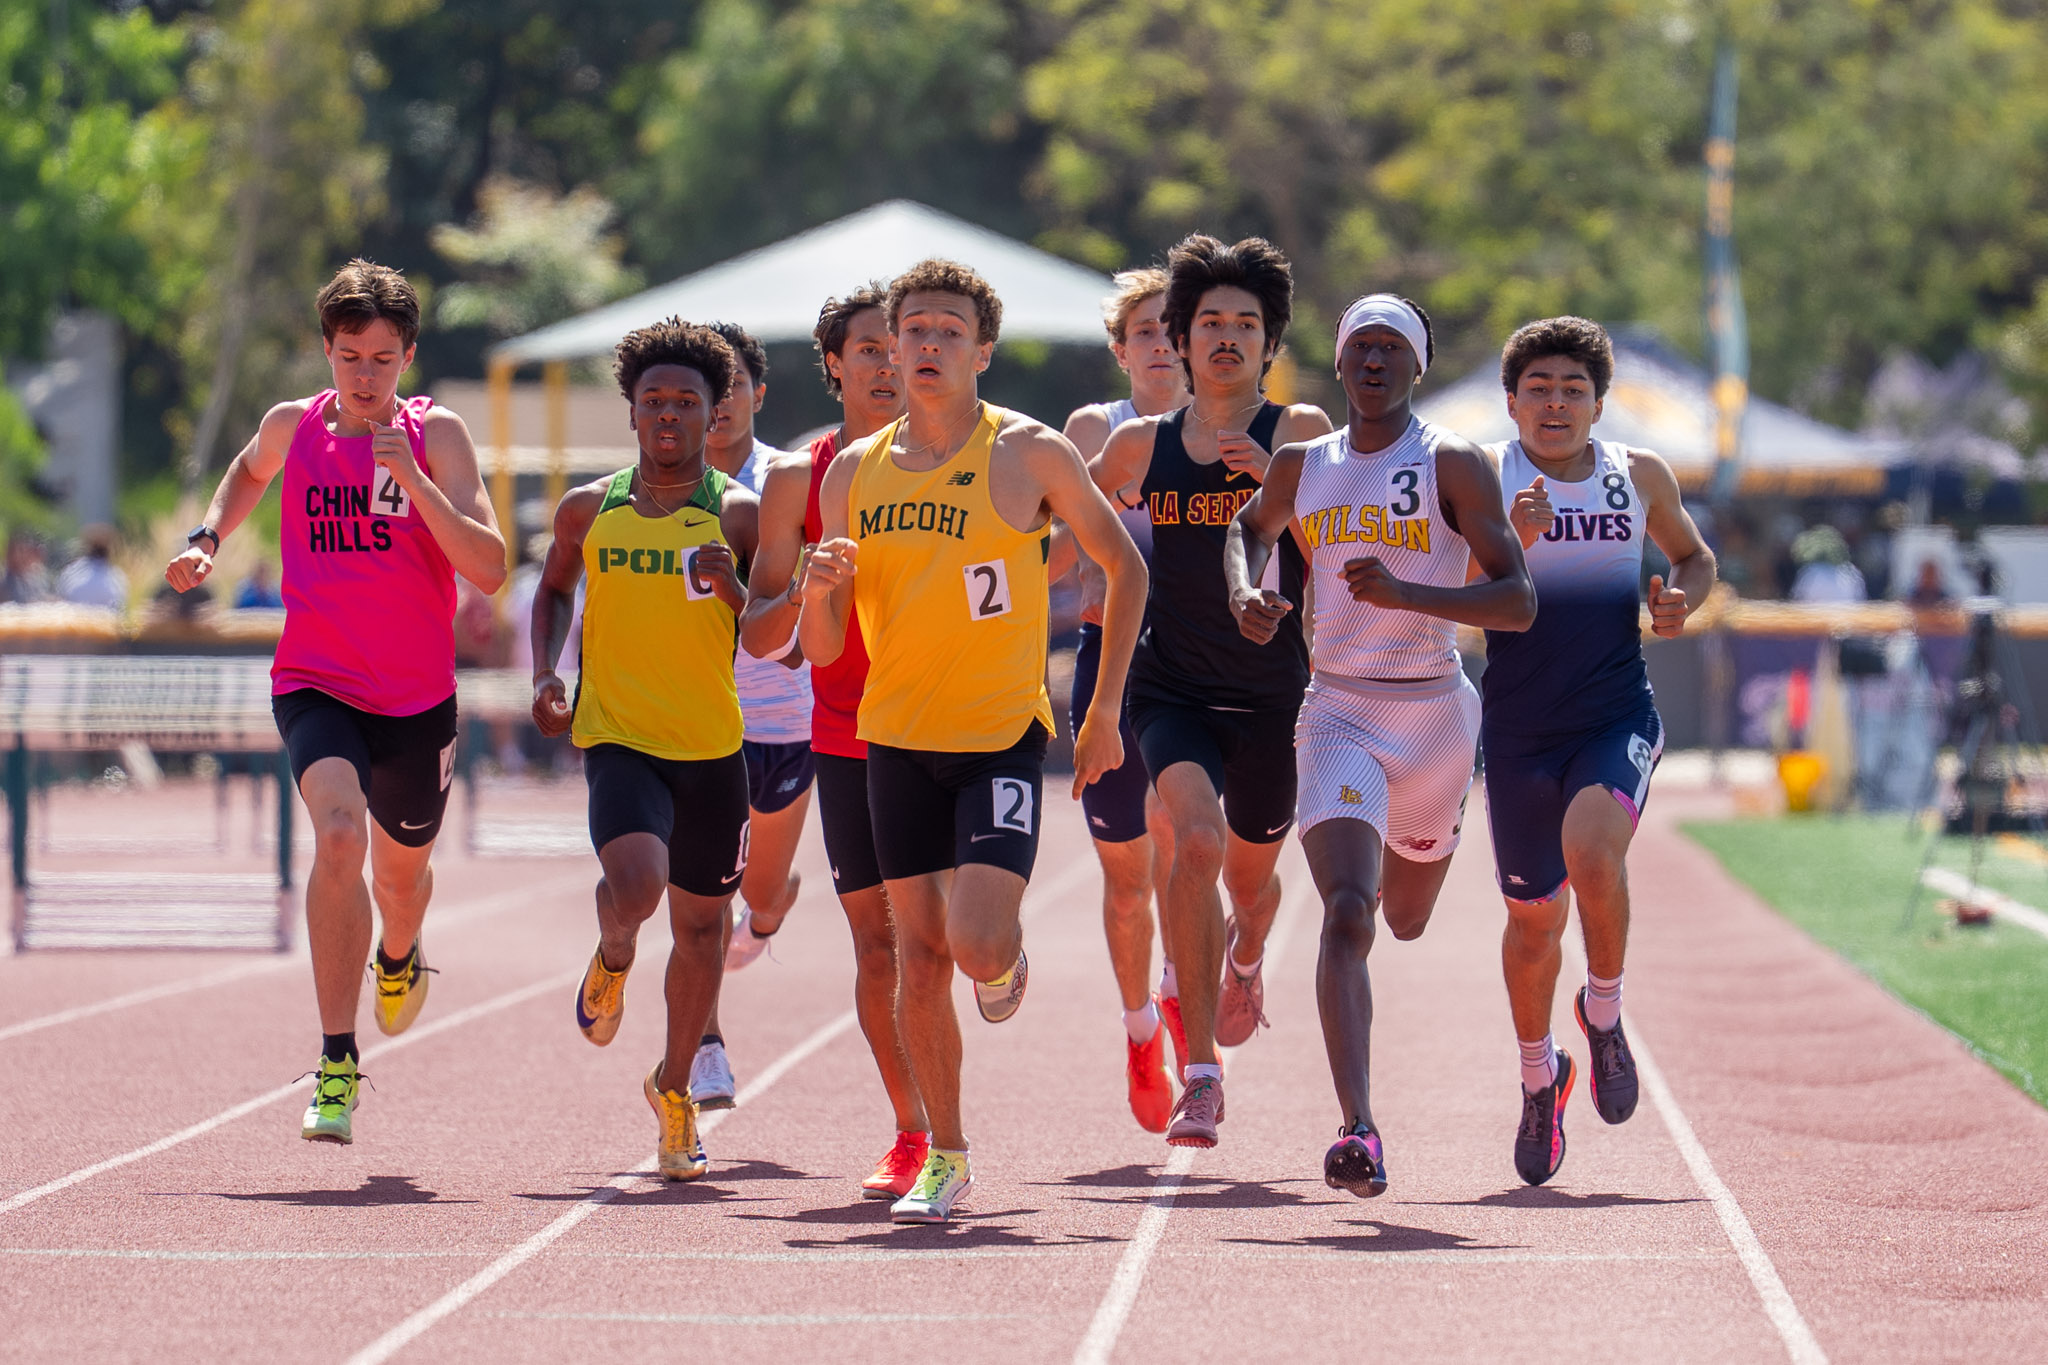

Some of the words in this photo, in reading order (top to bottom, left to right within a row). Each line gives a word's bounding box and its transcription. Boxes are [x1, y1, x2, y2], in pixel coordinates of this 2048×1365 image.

[306, 485, 388, 517] CHIN
[378, 474, 403, 513] 4
[1150, 491, 1180, 525] LA
[1187, 489, 1254, 525] SERN
[1391, 469, 1420, 516] 3
[1602, 472, 1630, 511] 8
[310, 520, 393, 552] HILLS
[859, 502, 969, 540] MICOHI
[1301, 504, 1431, 554] WILSON
[1536, 514, 1632, 542] OLVES
[598, 547, 684, 575] POL
[973, 565, 1003, 616] 2
[1002, 781, 1026, 829] 2
